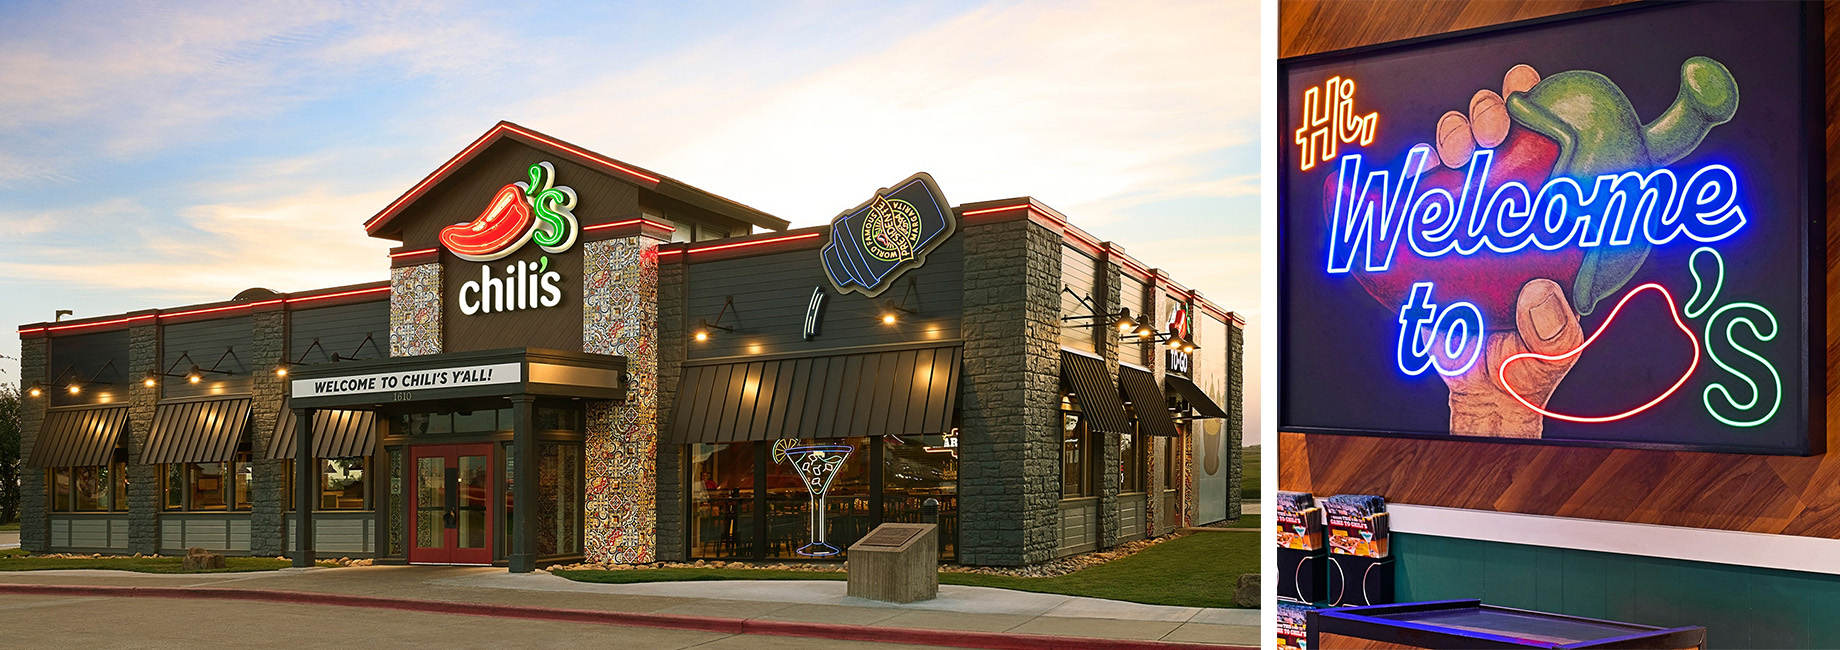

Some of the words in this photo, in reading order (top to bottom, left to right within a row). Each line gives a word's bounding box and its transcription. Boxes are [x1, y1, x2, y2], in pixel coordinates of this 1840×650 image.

[1296, 76, 1378, 171] Hi,
[864, 212, 878, 246] FAMOUS
[877, 201, 910, 257] PRESIDENTE
[893, 201, 919, 241] MARGARITA
[1328, 147, 1747, 273] Welcome
[870, 246, 898, 259] WORLD
[458, 256, 562, 315] chili's
[1398, 282, 1485, 376] to
[315, 377, 376, 393] WELCOME
[381, 376, 398, 389] TO
[402, 372, 448, 387] CHILI'S
[452, 368, 493, 383] Y'ALL!
[1170, 349, 1188, 373] TO-GO
[393, 392, 412, 401] 1610
